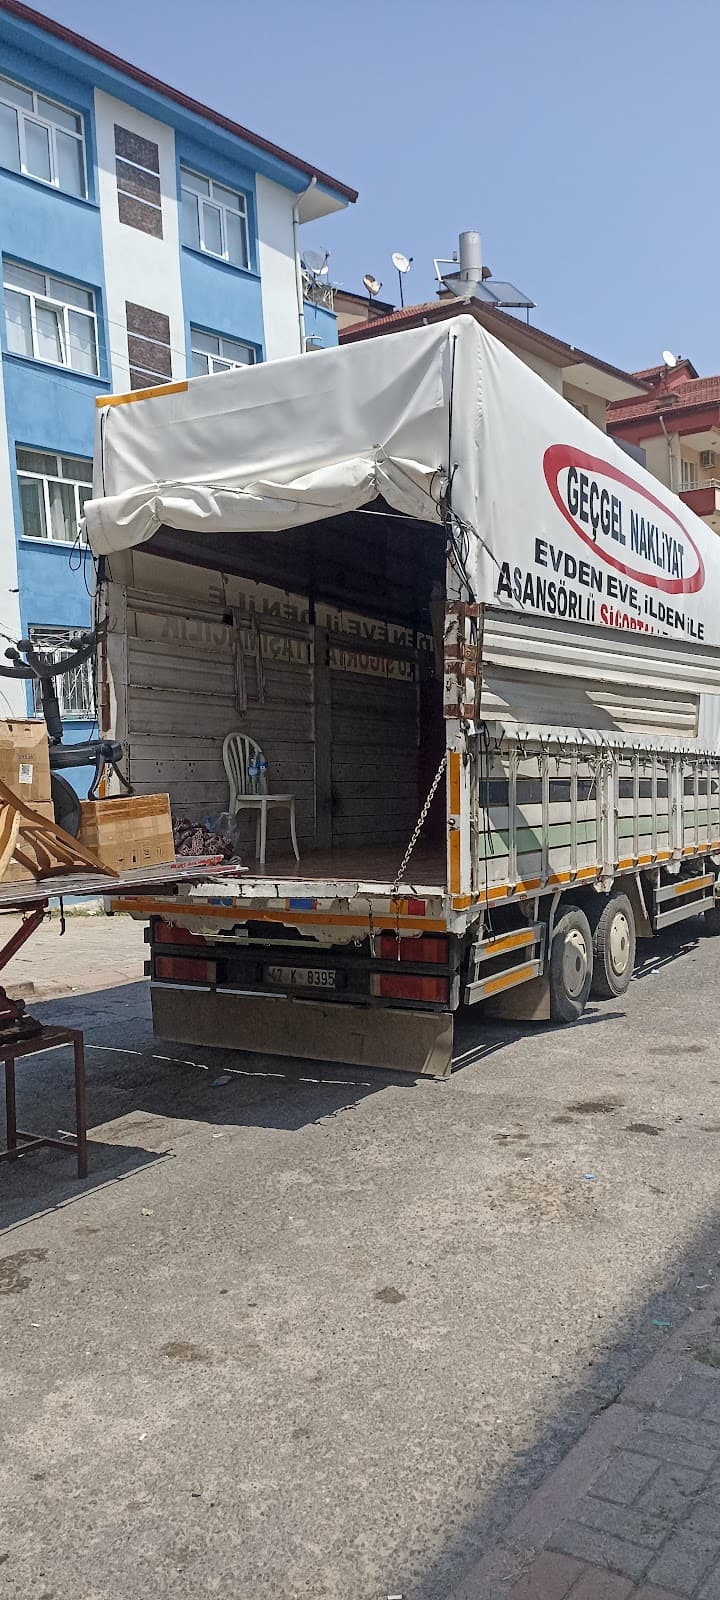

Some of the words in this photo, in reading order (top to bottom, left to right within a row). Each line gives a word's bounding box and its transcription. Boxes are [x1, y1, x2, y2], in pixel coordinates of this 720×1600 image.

[567, 466, 626, 545] GEÇGEL
[497, 561, 594, 622] ASANSÖRLÜ
[535, 538, 602, 593] EVDEN
[606, 572, 641, 615] EVE,
[290, 969, 298, 984] K
[307, 970, 335, 986] 8395
